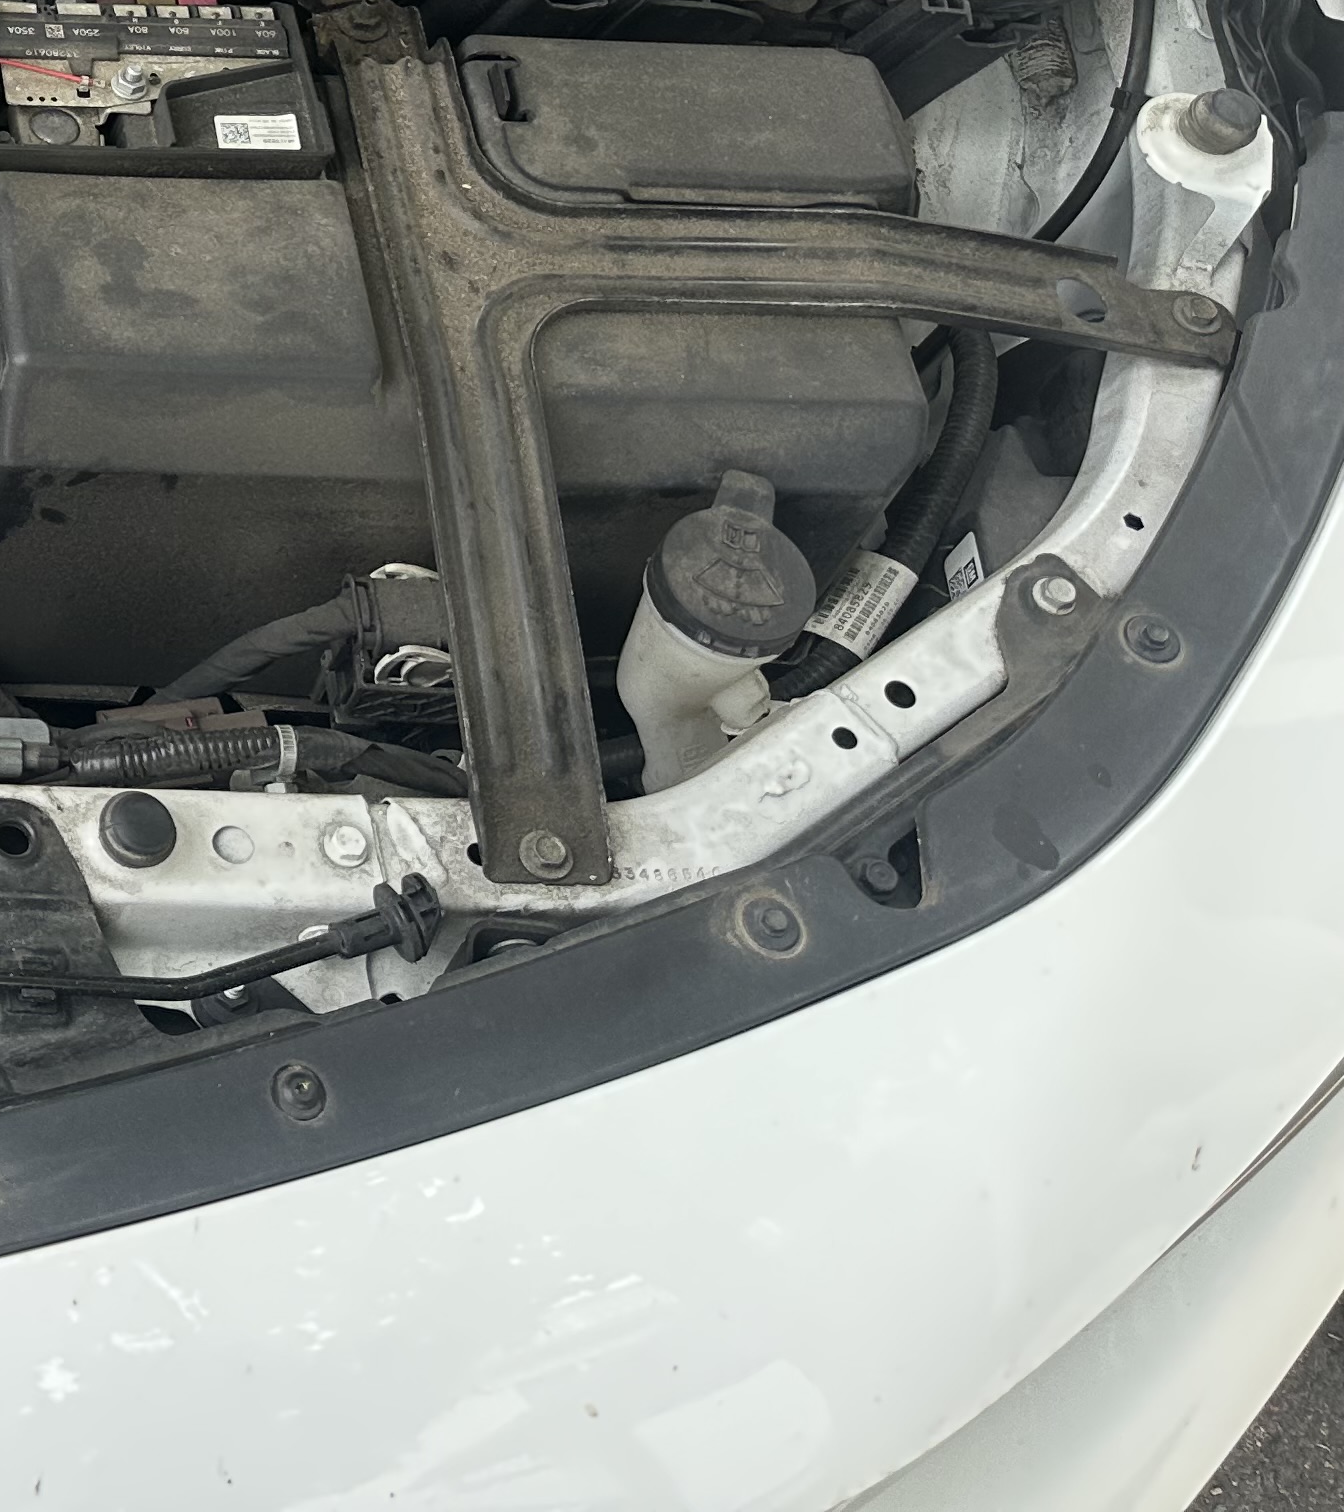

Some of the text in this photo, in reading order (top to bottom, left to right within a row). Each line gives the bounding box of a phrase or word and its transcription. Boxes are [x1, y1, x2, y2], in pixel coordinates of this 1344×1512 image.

[7, 25, 36, 35] 350A
[72, 28, 100, 37] 250A
[209, 28, 237, 37] 100A
